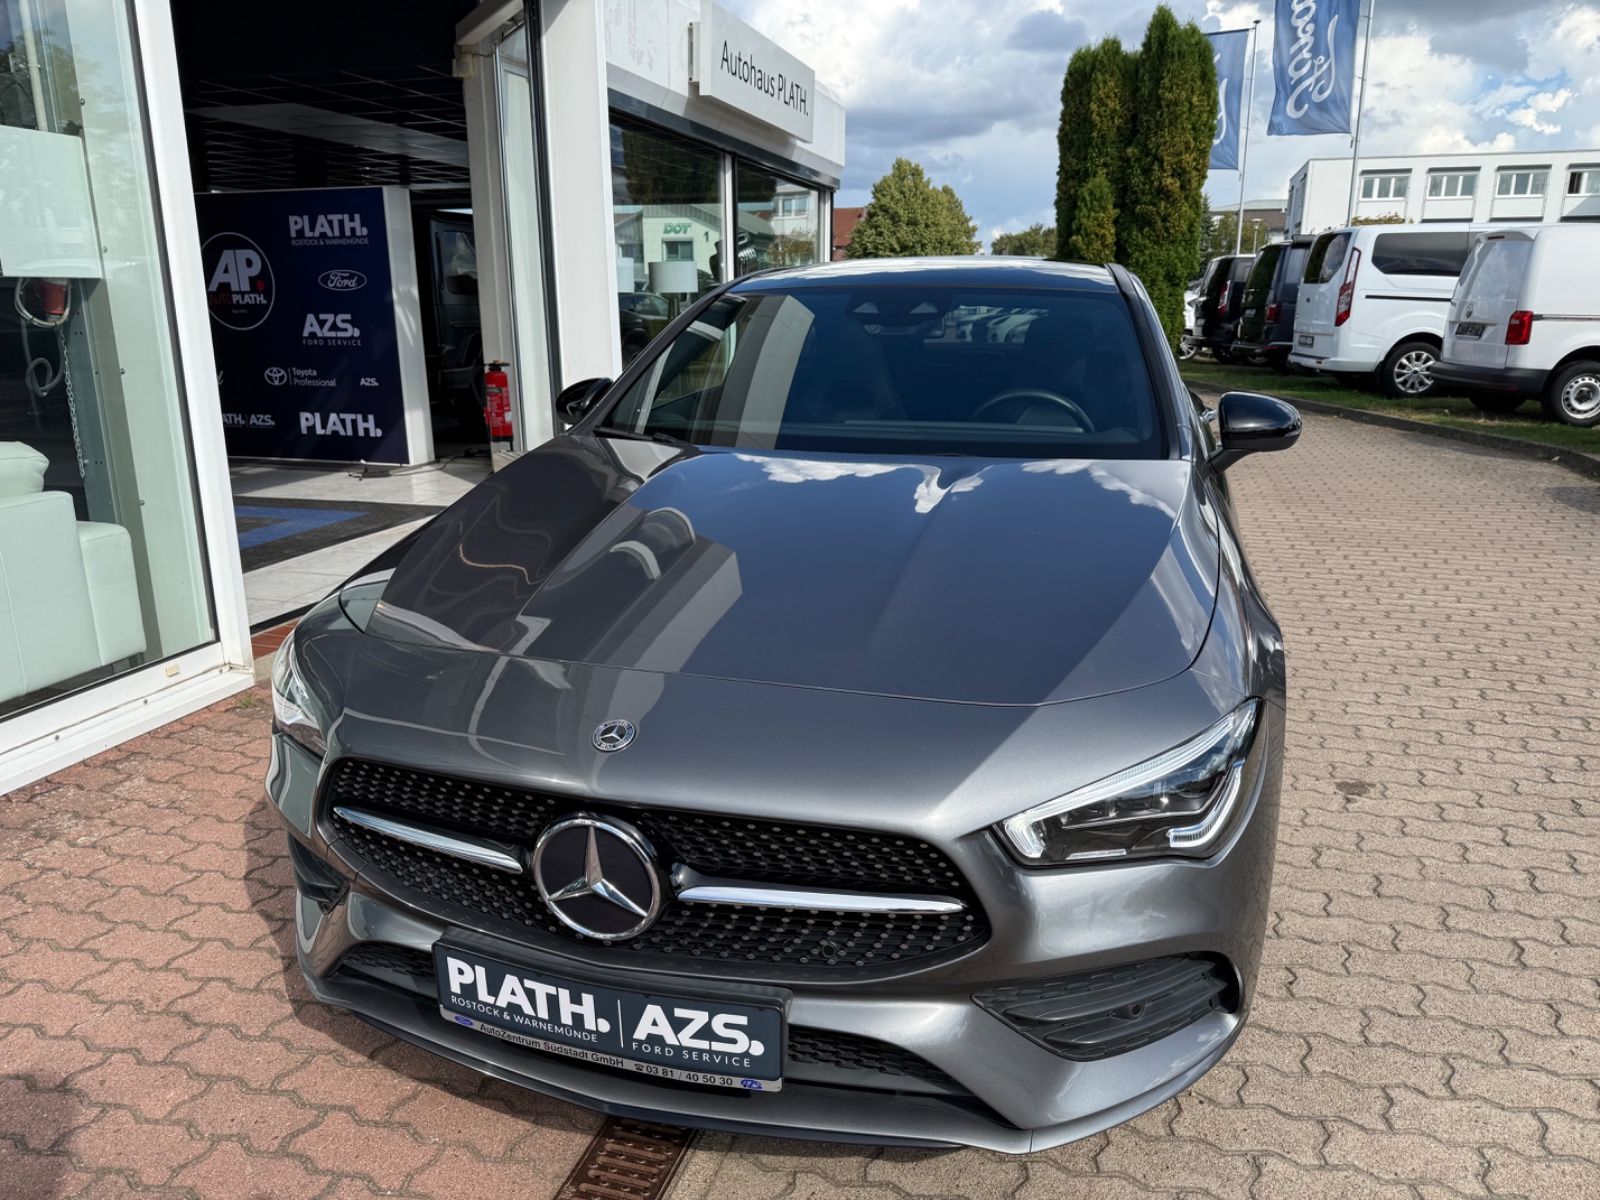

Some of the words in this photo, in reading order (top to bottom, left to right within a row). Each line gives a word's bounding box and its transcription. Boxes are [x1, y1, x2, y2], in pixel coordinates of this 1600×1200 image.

[720, 39, 775, 98] Autohaus
[778, 72, 809, 117] PLATH.
[288, 213, 368, 238] PLATH.
[327, 271, 358, 287] Ford
[302, 313, 361, 338] AZS.
[302, 338, 325, 346] FORD
[327, 338, 362, 347] SERVICE
[292, 367, 317, 377] Toyota
[293, 377, 337, 387] Professional
[360, 377, 379, 387] AZS.
[223, 413, 245, 425] ATH.
[249, 413, 276, 426] AZS.
[299, 412, 383, 437] PLATH.
[446, 956, 611, 1033] PLATH.
[632, 1003, 765, 1056] AZS.
[451, 995, 500, 1017] ROSTOCK
[503, 1011, 511, 1021] &
[513, 1014, 598, 1043] WARNEMÜNDE
[480, 1024, 541, 1048] AutoZentrum
[591, 1052, 624, 1067] GmbH
[632, 1042, 674, 1056] FORD
[682, 1050, 750, 1067] SERVICE
[645, 1066, 659, 1075] 03
[662, 1068, 674, 1077] 81
[685, 1072, 699, 1082] 40
[702, 1074, 716, 1084] 50
[719, 1076, 733, 1086] 30
